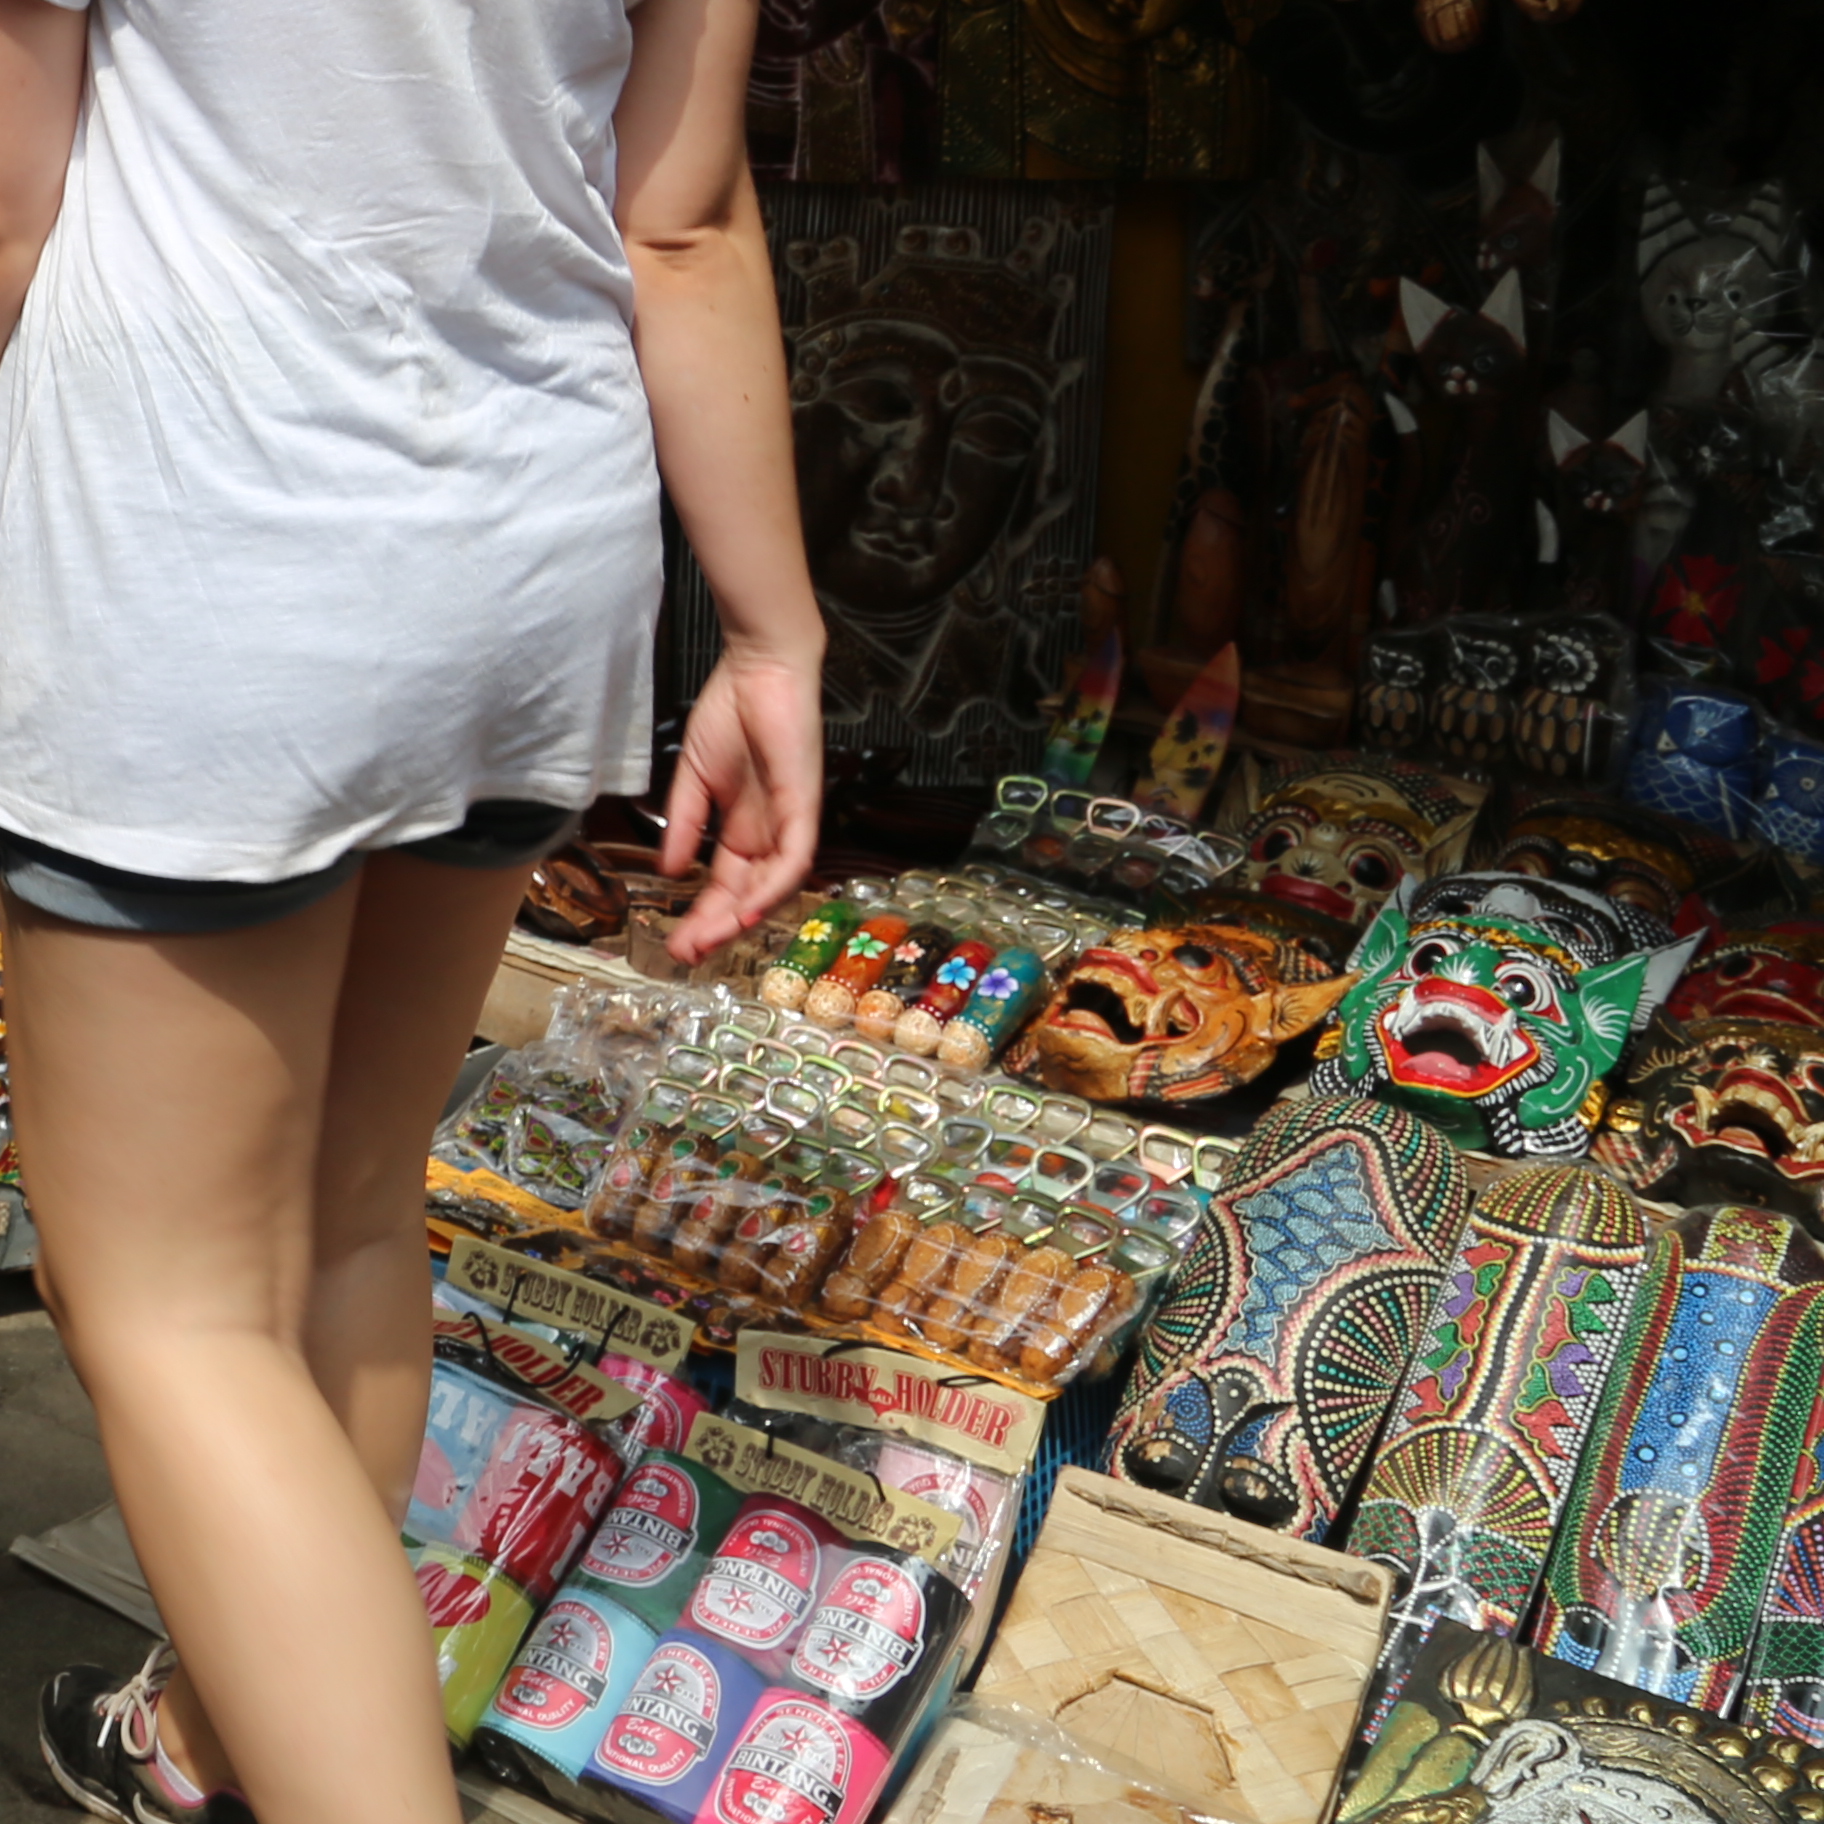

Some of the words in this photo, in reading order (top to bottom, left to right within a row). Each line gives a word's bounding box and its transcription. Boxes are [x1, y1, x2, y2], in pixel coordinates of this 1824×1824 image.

[499, 1262, 574, 1316] STUBBY
[570, 1285, 645, 1345] HOLDER
[488, 1333, 607, 1417] HOLDER
[758, 1346, 880, 1404] STUBBY
[893, 1369, 1014, 1449] HOLDER
[733, 1442, 813, 1496] STUBBY
[809, 1475, 896, 1537] HOLDER
[606, 1508, 683, 1550] BINTAN
[711, 1559, 802, 1611] BINTANG
[813, 1609, 908, 1661] BINTANG
[524, 1649, 592, 1689] NTANG
[537, 1697, 576, 1722] QUALITY
[623, 1696, 700, 1739] INTANG
[625, 1716, 666, 1741] Bali
[647, 1748, 687, 1774] QUALITY
